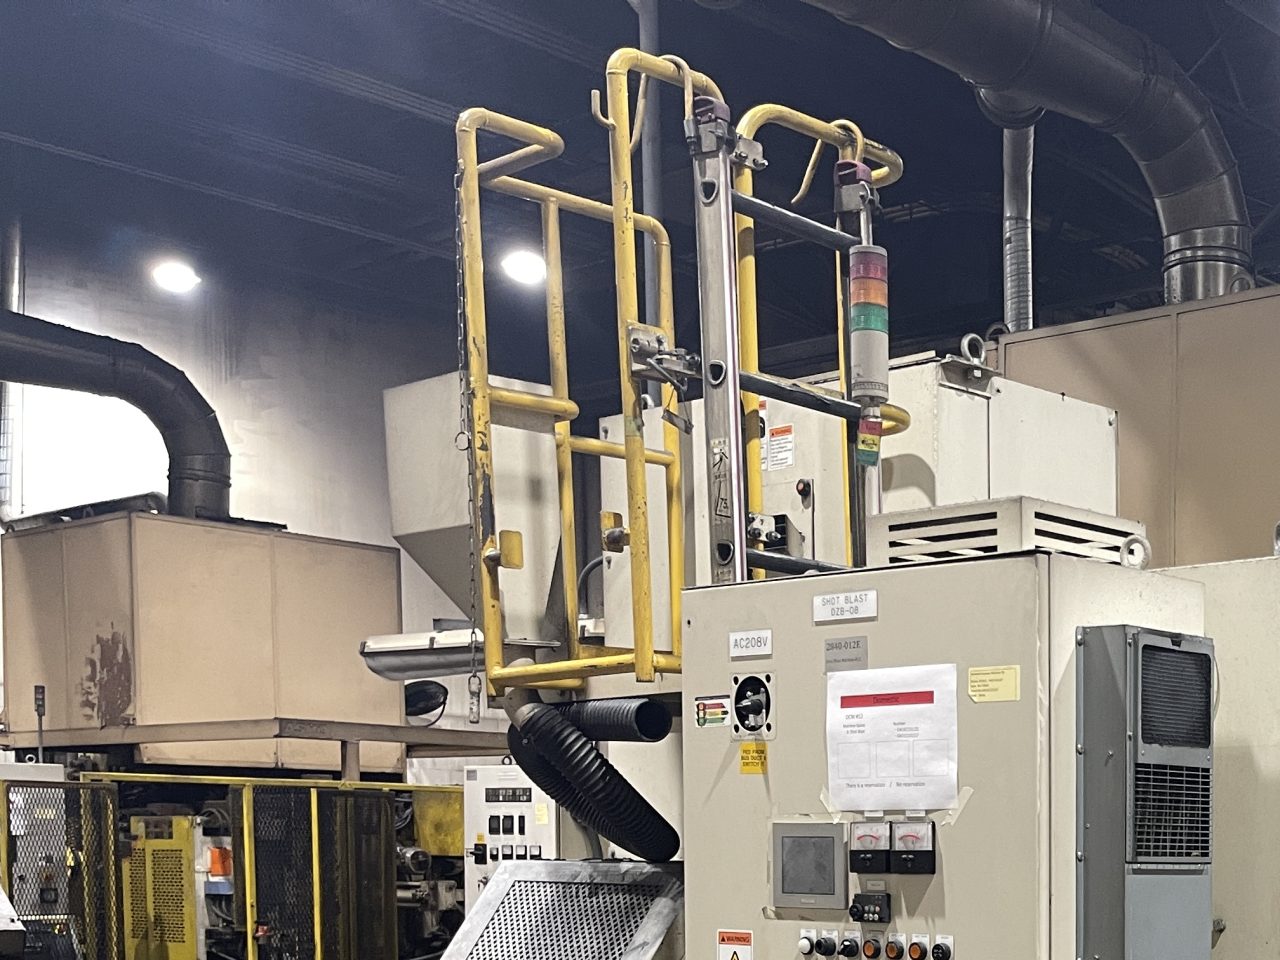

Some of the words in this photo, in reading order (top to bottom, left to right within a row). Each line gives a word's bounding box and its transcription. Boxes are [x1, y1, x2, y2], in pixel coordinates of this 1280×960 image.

[822, 596, 840, 606] SHOT
[844, 594, 868, 604] BLAST
[733, 637, 768, 649] AC208V
